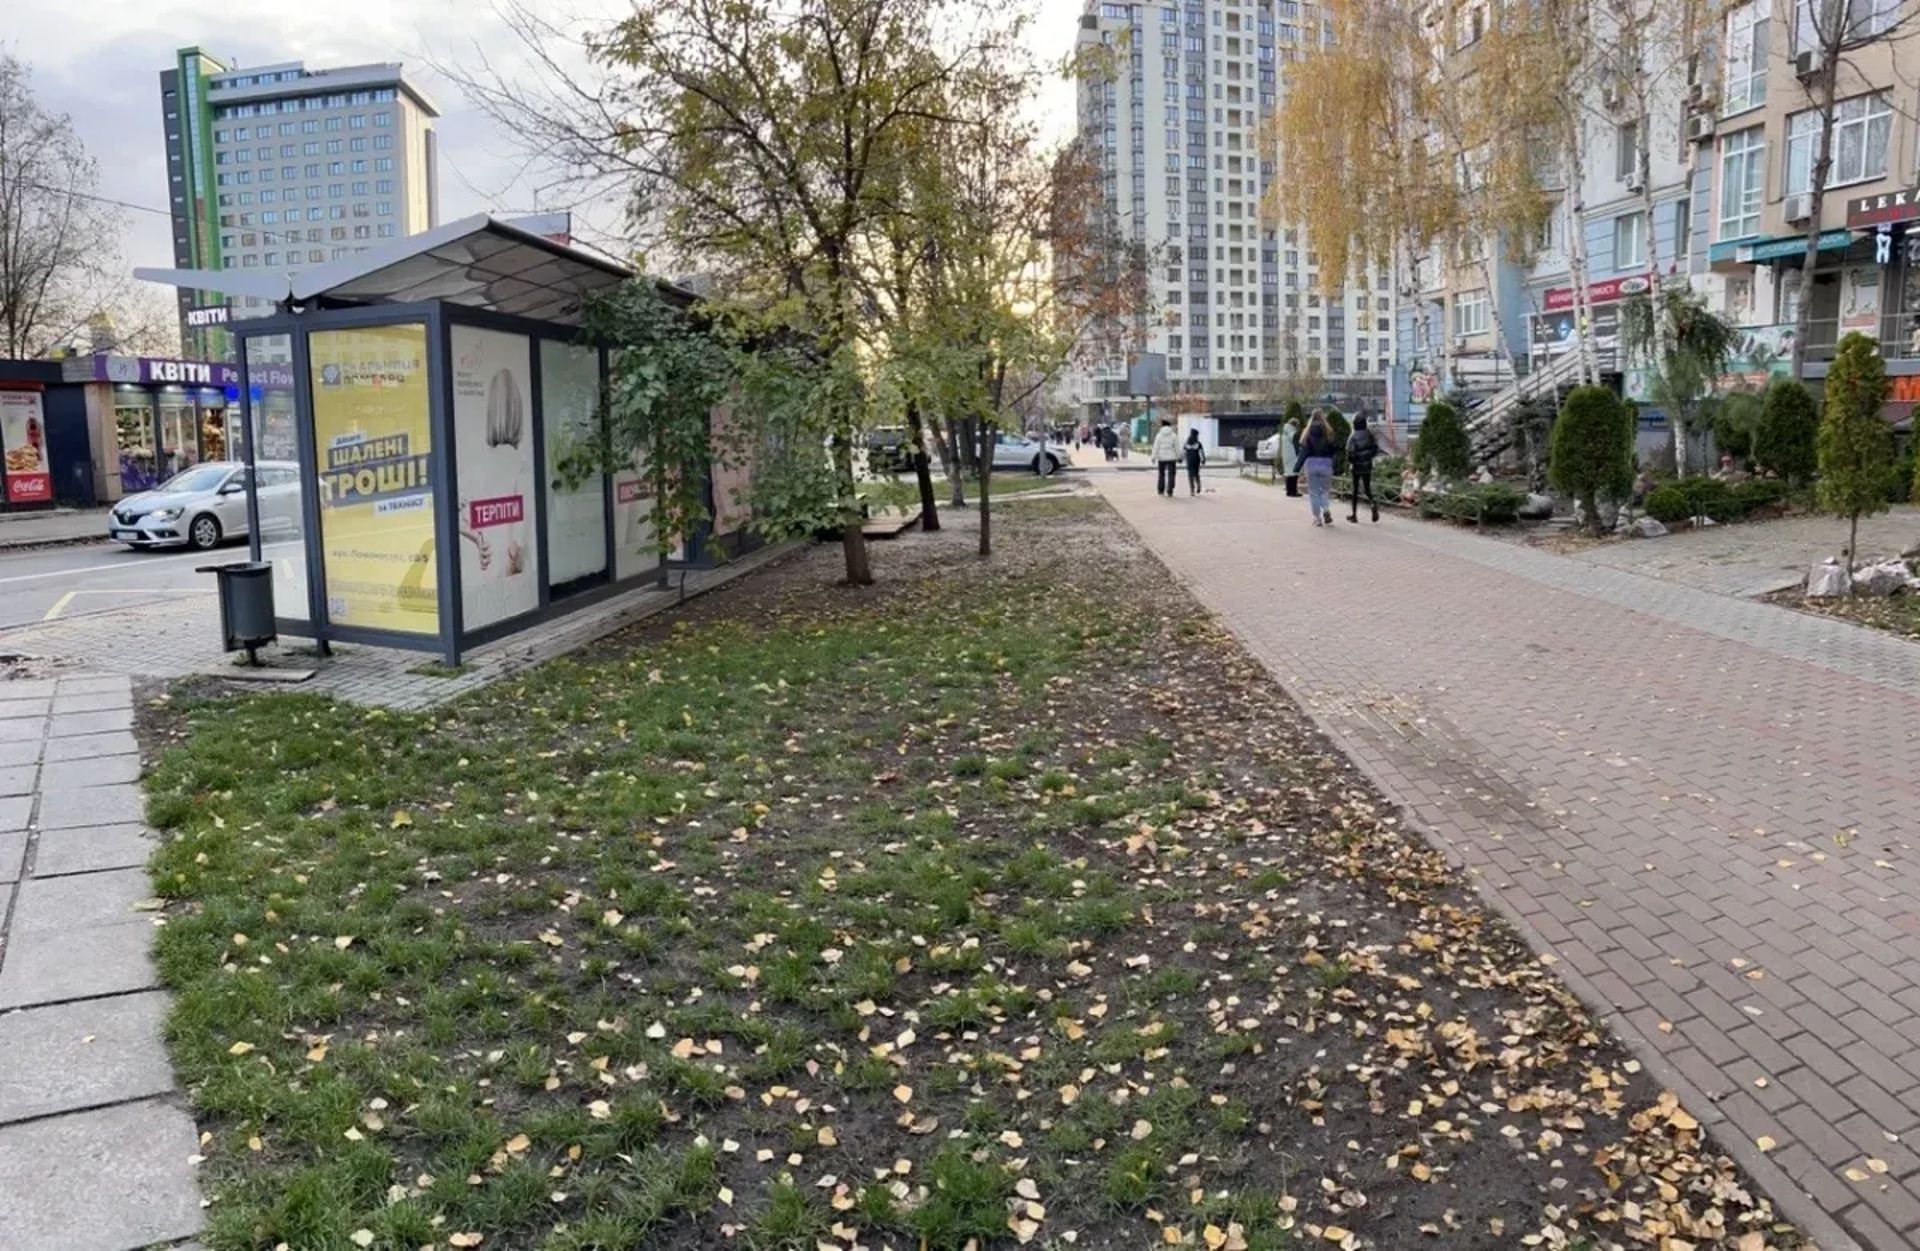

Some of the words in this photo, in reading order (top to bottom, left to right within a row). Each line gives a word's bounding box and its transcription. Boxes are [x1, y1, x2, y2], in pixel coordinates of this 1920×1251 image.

[188, 308, 228, 326] КВІТИ
[150, 361, 211, 383] КВІТИ
[222, 367, 267, 384] Peect
[333, 437, 404, 466] ШАЛЕНІ
[474, 500, 520, 524] ТЕРПІТИ
